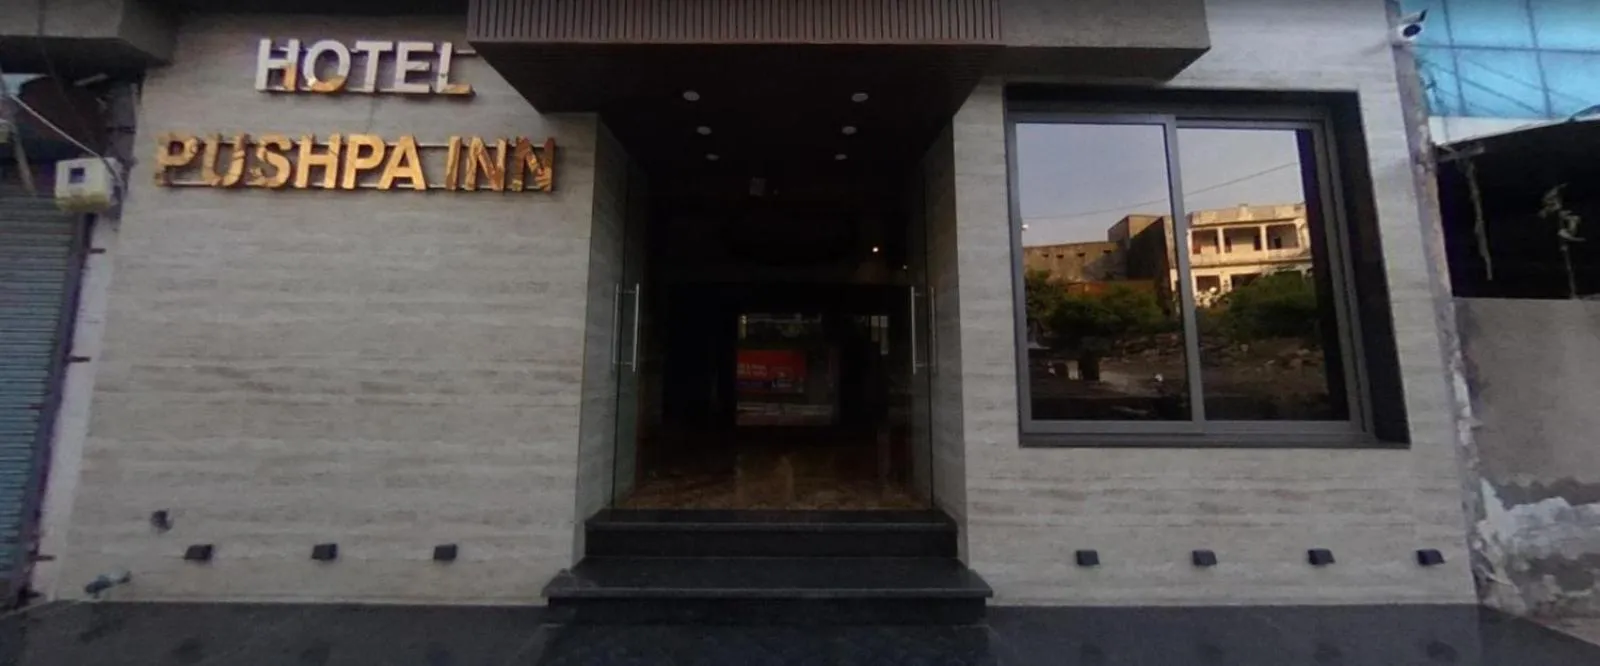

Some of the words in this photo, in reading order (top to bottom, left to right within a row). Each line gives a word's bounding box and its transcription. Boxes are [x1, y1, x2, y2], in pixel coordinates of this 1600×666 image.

[254, 38, 475, 95] HOTEL
[154, 132, 427, 191] PUSHPA
[445, 136, 556, 192] INN
